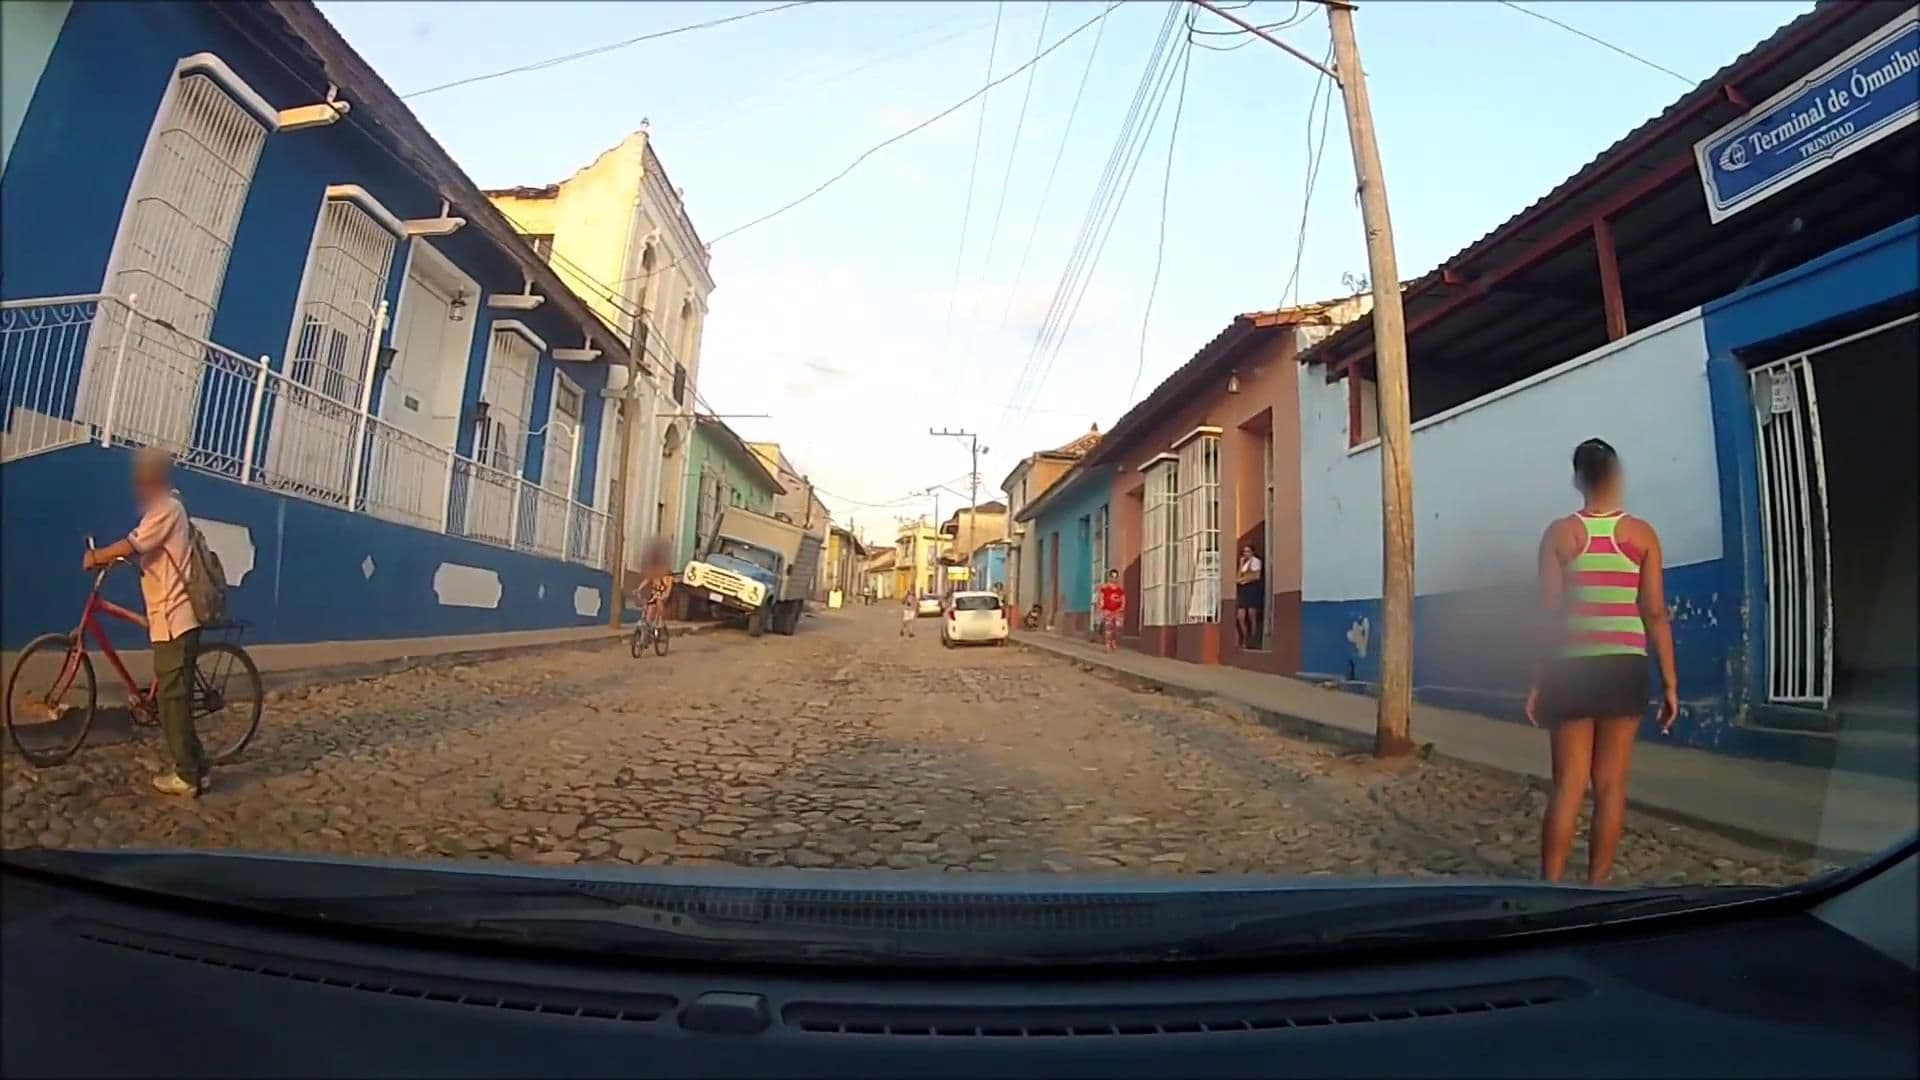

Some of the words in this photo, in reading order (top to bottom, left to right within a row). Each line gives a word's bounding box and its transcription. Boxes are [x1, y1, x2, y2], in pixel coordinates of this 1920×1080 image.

[1750, 98, 1826, 155] Terminal
[1828, 90, 1849, 113] de
[1850, 47, 1920, 98] Ómnibu
[1800, 123, 1855, 156] TRINIDAD
